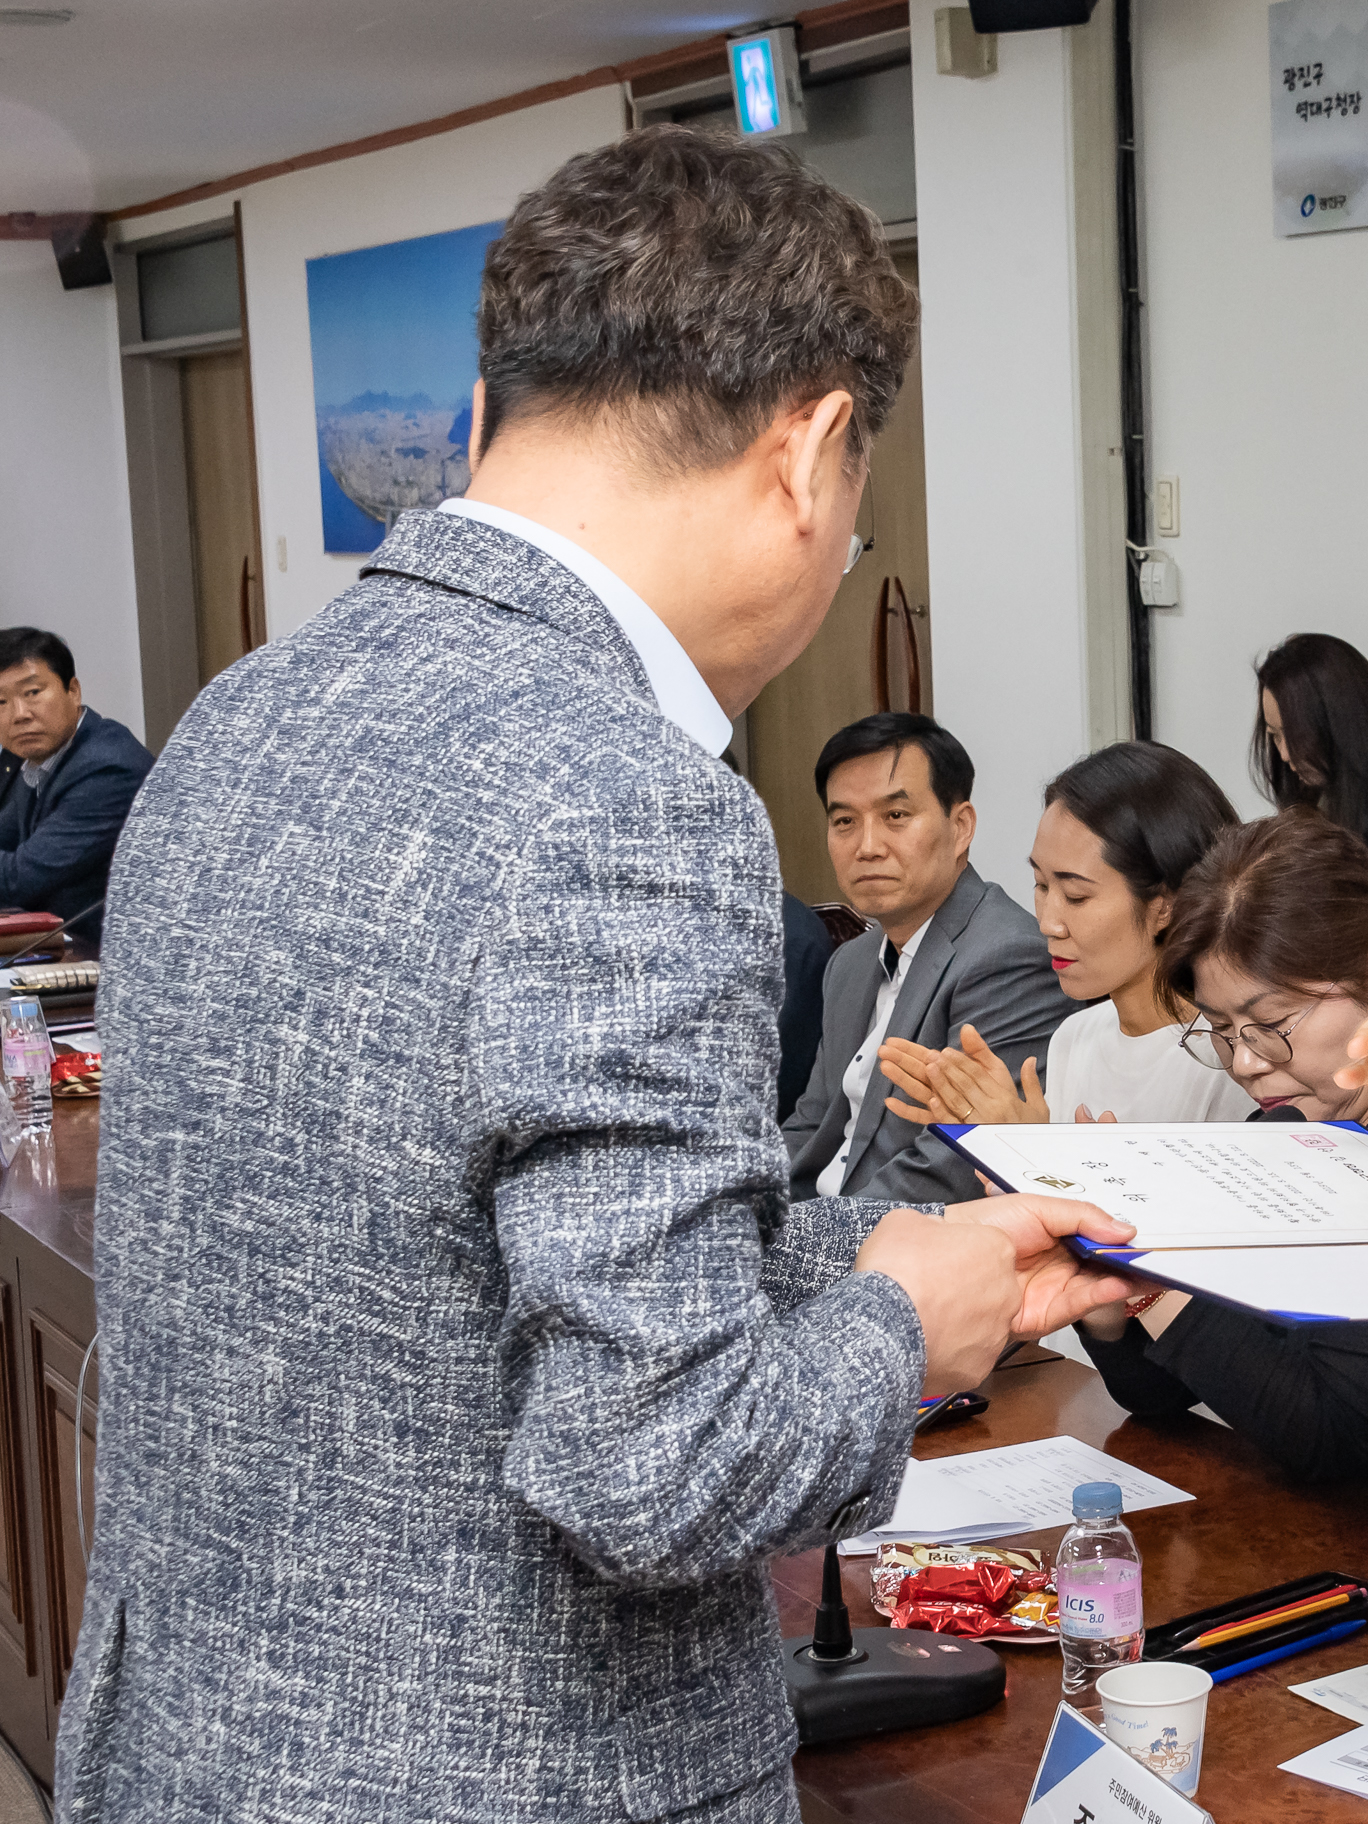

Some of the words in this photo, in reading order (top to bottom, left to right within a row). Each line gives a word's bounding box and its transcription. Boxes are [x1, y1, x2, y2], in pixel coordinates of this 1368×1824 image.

[1283, 62, 1324, 91] 광진구
[1296, 91, 1362, 122] 역대구청장
[1089, 1613, 1105, 1624] 8.0
